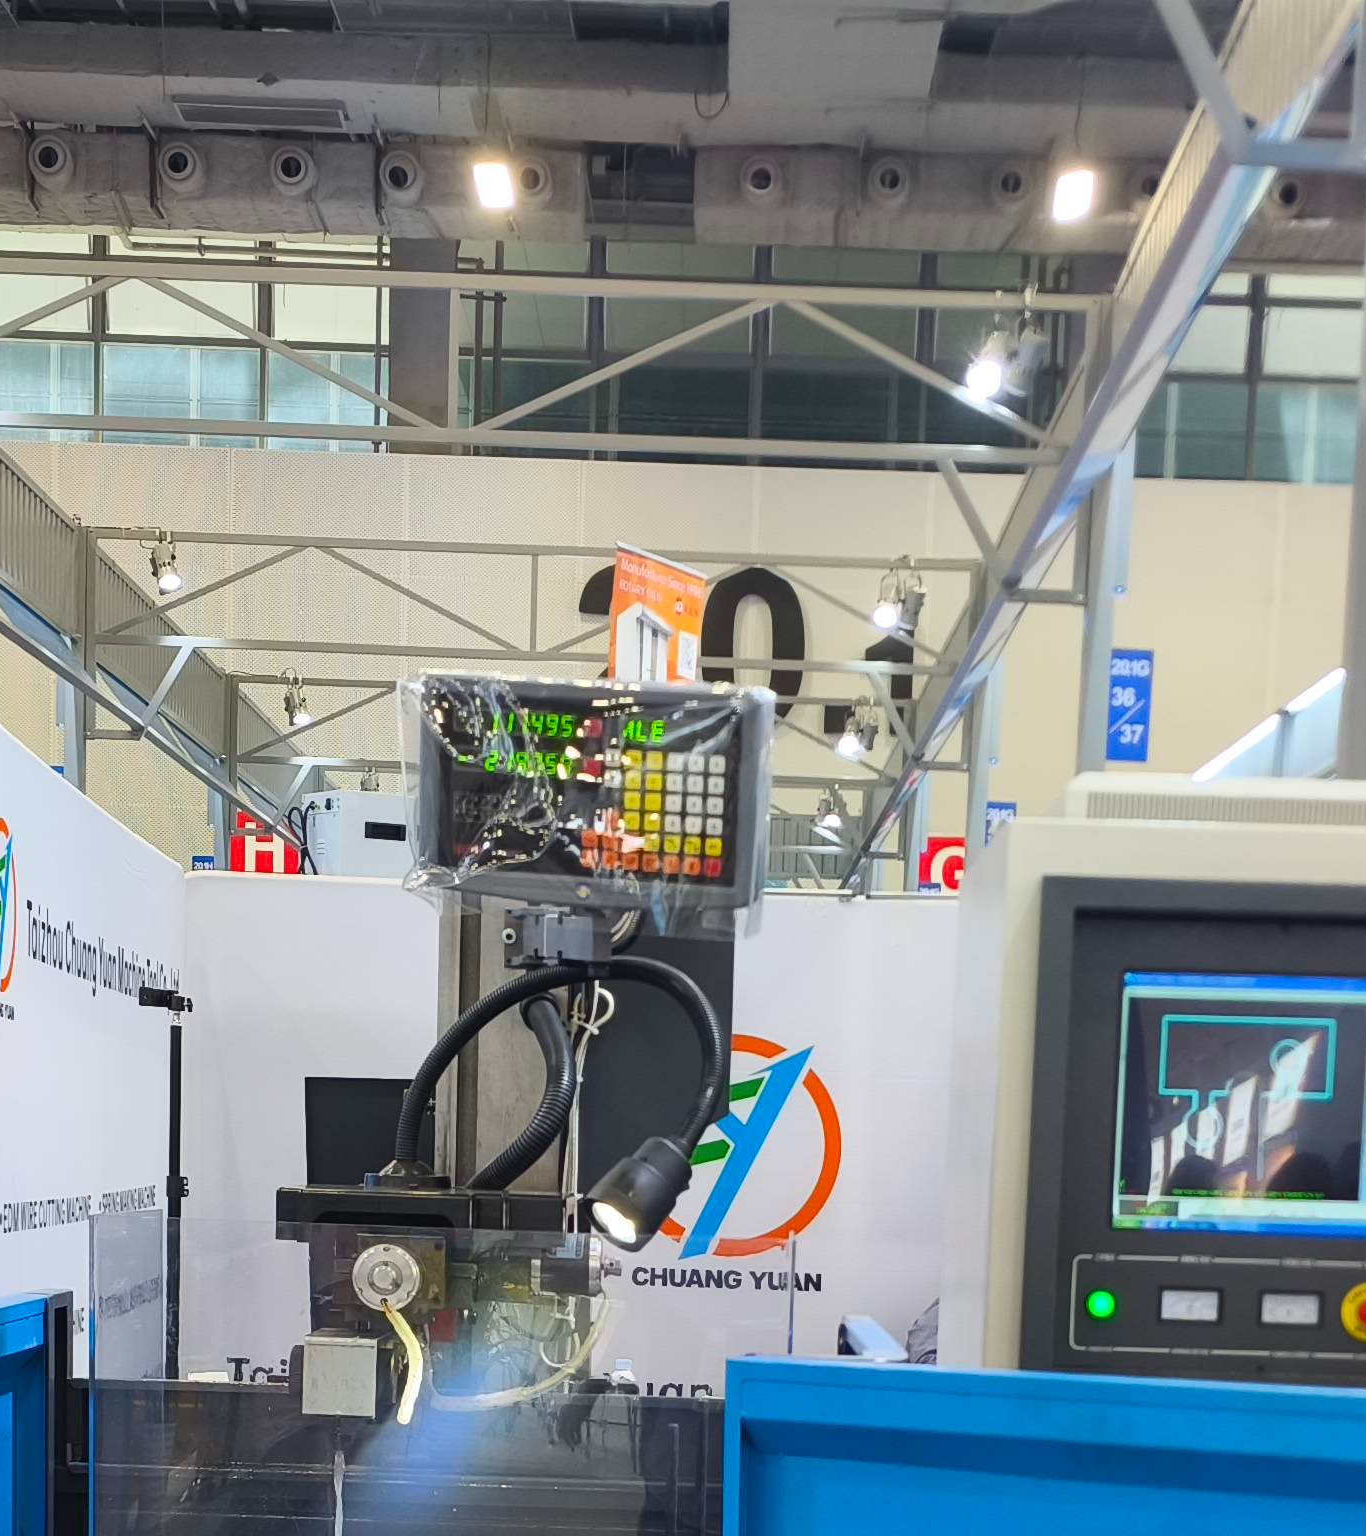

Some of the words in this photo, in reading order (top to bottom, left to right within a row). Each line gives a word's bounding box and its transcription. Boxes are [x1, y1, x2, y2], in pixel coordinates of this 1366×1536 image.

[1111, 686, 1136, 708] 36
[1120, 723, 1144, 744] 37
[245, 821, 285, 872] H
[26, 899, 63, 970] Taizhou
[65, 920, 96, 997] Chuang
[98, 936, 117, 991] Yuan
[38, 1198, 65, 1228] CUTTING
[66, 1194, 92, 1224] MACHINE
[632, 1266, 742, 1289] CHUANG
[749, 1270, 822, 1292] YUAN
